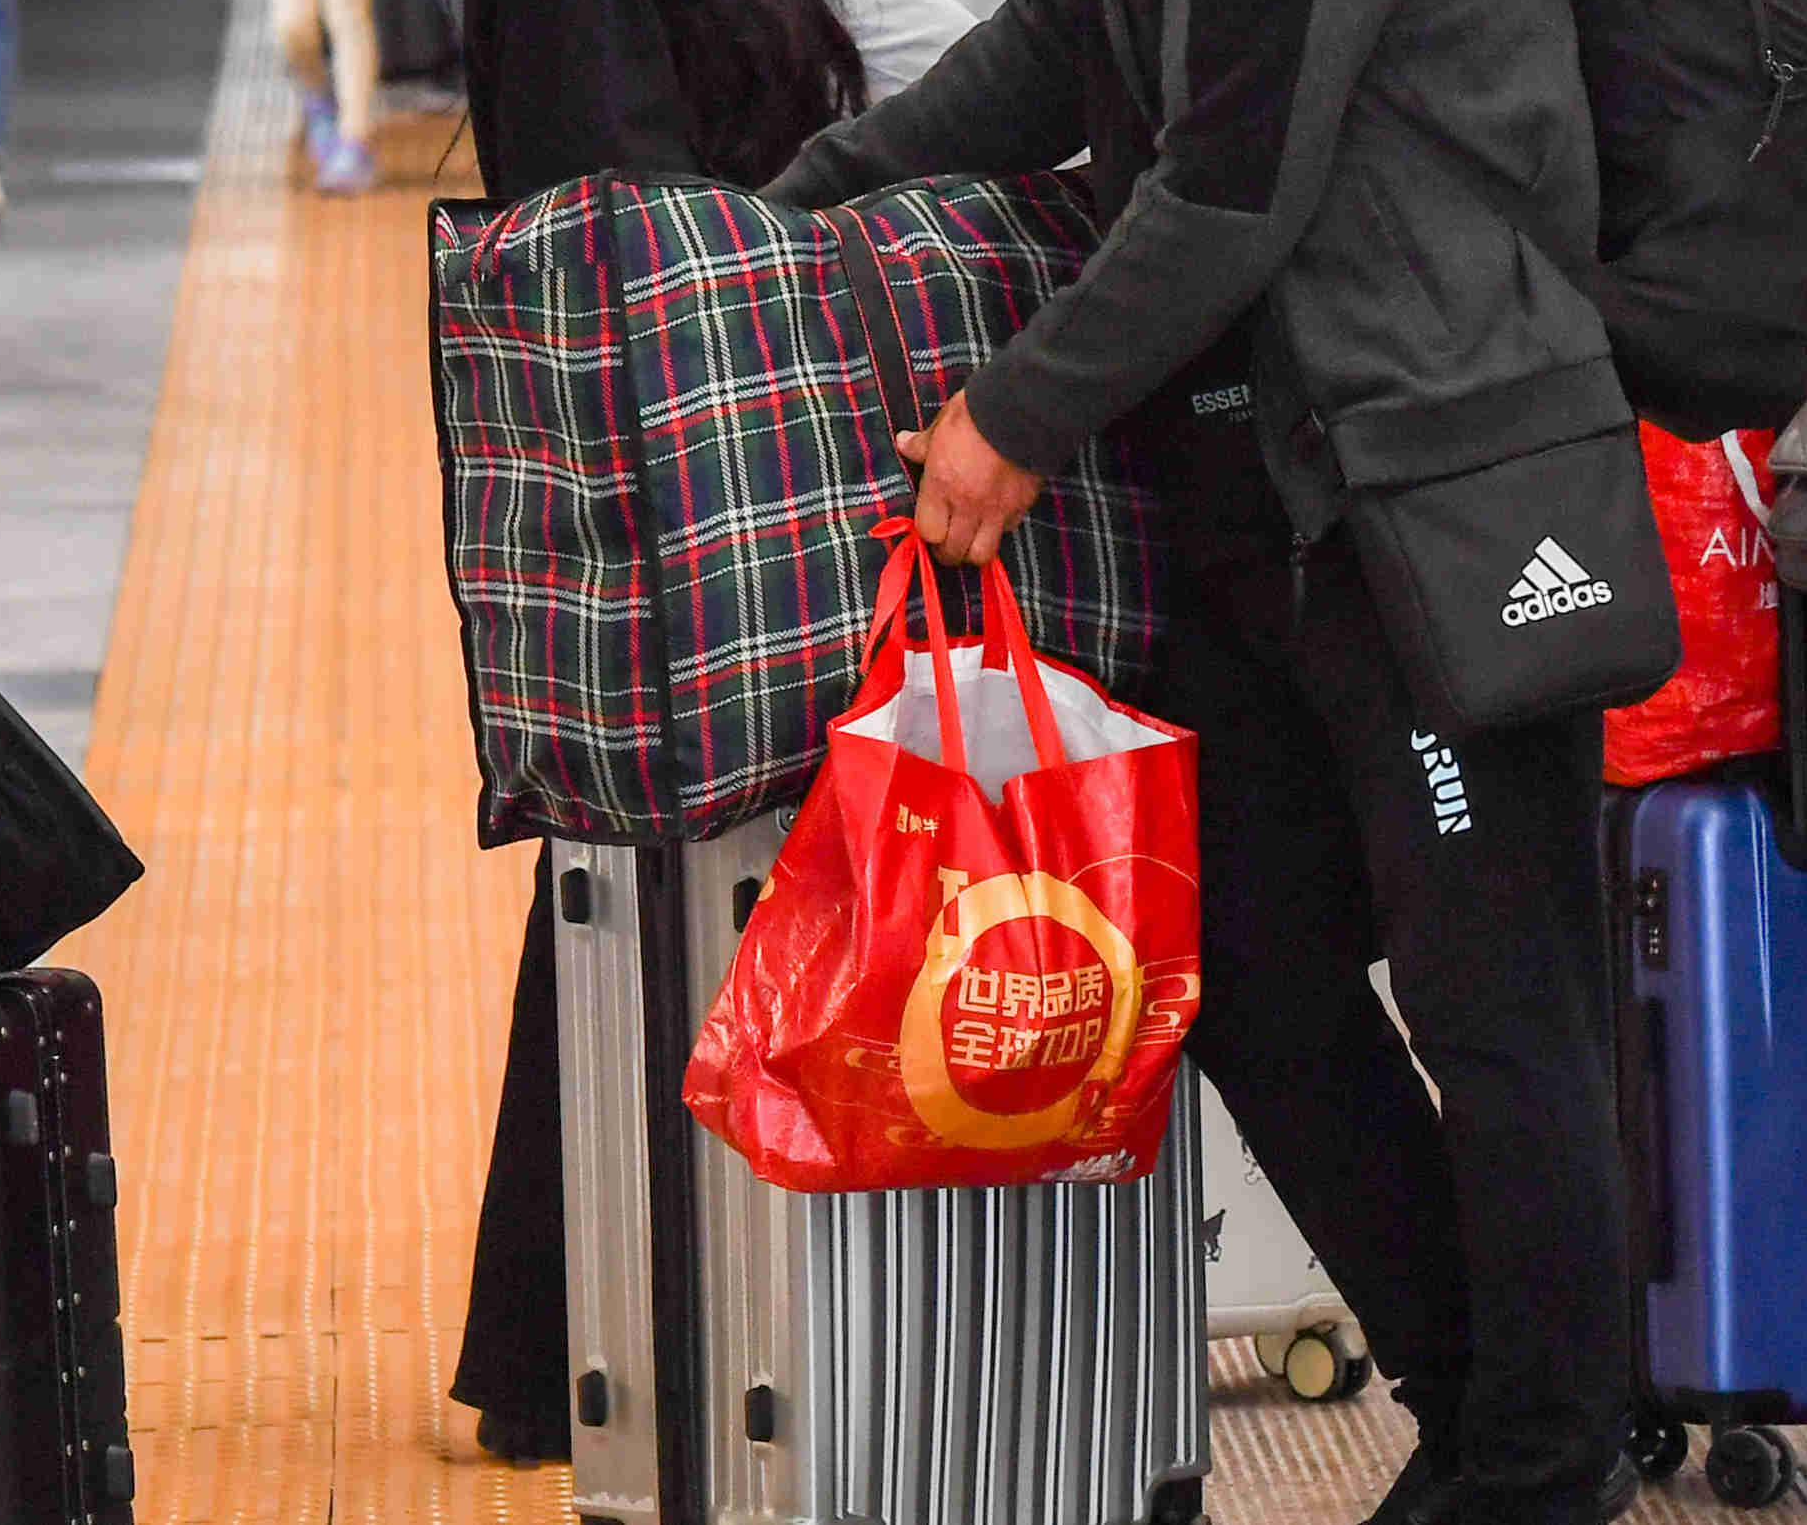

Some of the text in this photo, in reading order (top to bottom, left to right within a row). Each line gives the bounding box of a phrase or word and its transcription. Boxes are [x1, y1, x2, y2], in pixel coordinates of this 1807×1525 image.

[1501, 580, 1614, 627] adidas
[958, 962, 1104, 1020] 世界品质
